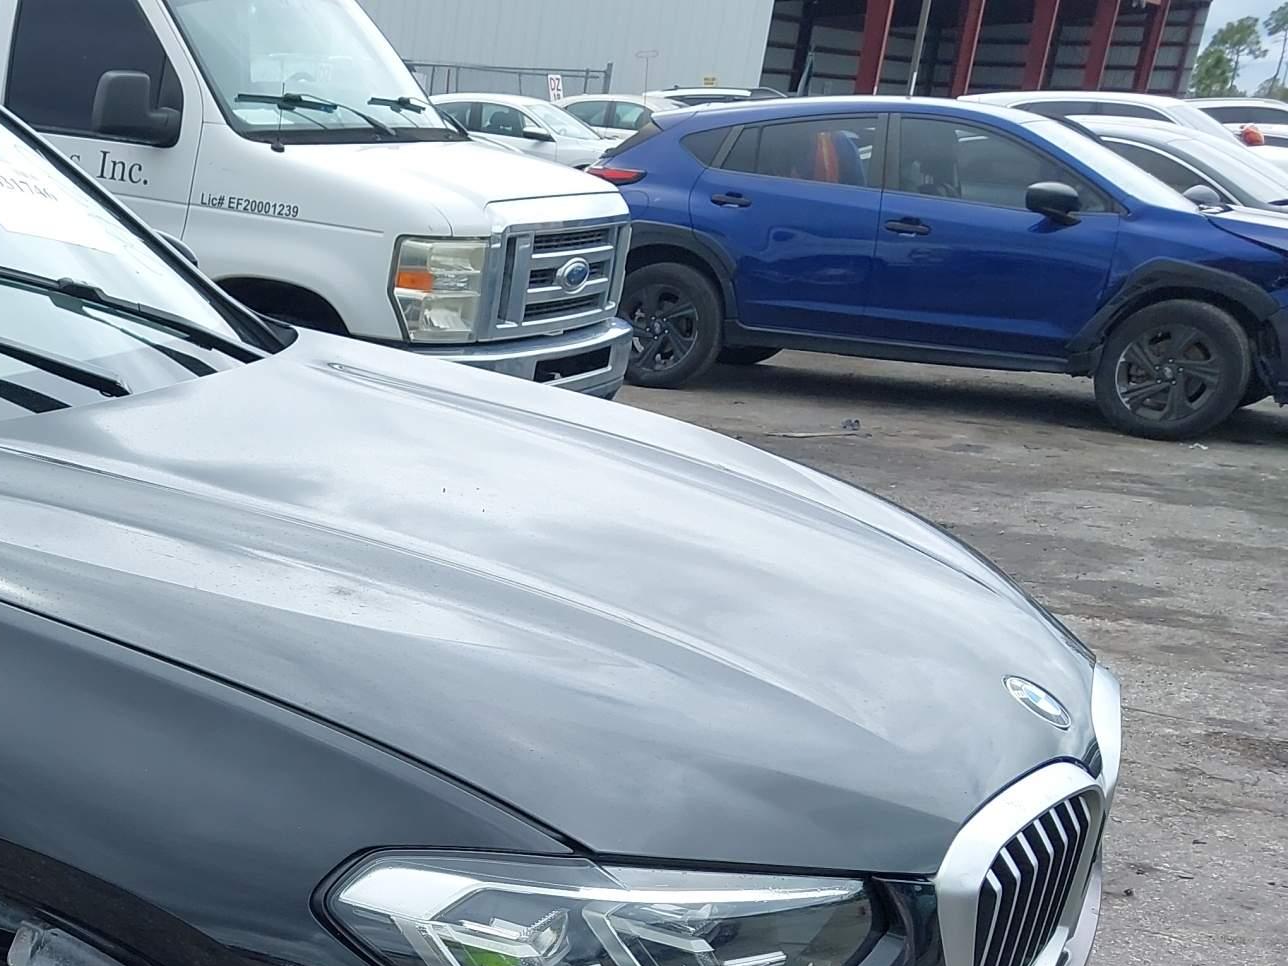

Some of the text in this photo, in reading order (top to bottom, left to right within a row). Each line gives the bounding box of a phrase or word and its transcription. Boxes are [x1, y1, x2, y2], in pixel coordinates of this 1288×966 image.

[96, 150, 148, 185] Inc.
[200, 192, 299, 218] Lic# EF20001239
